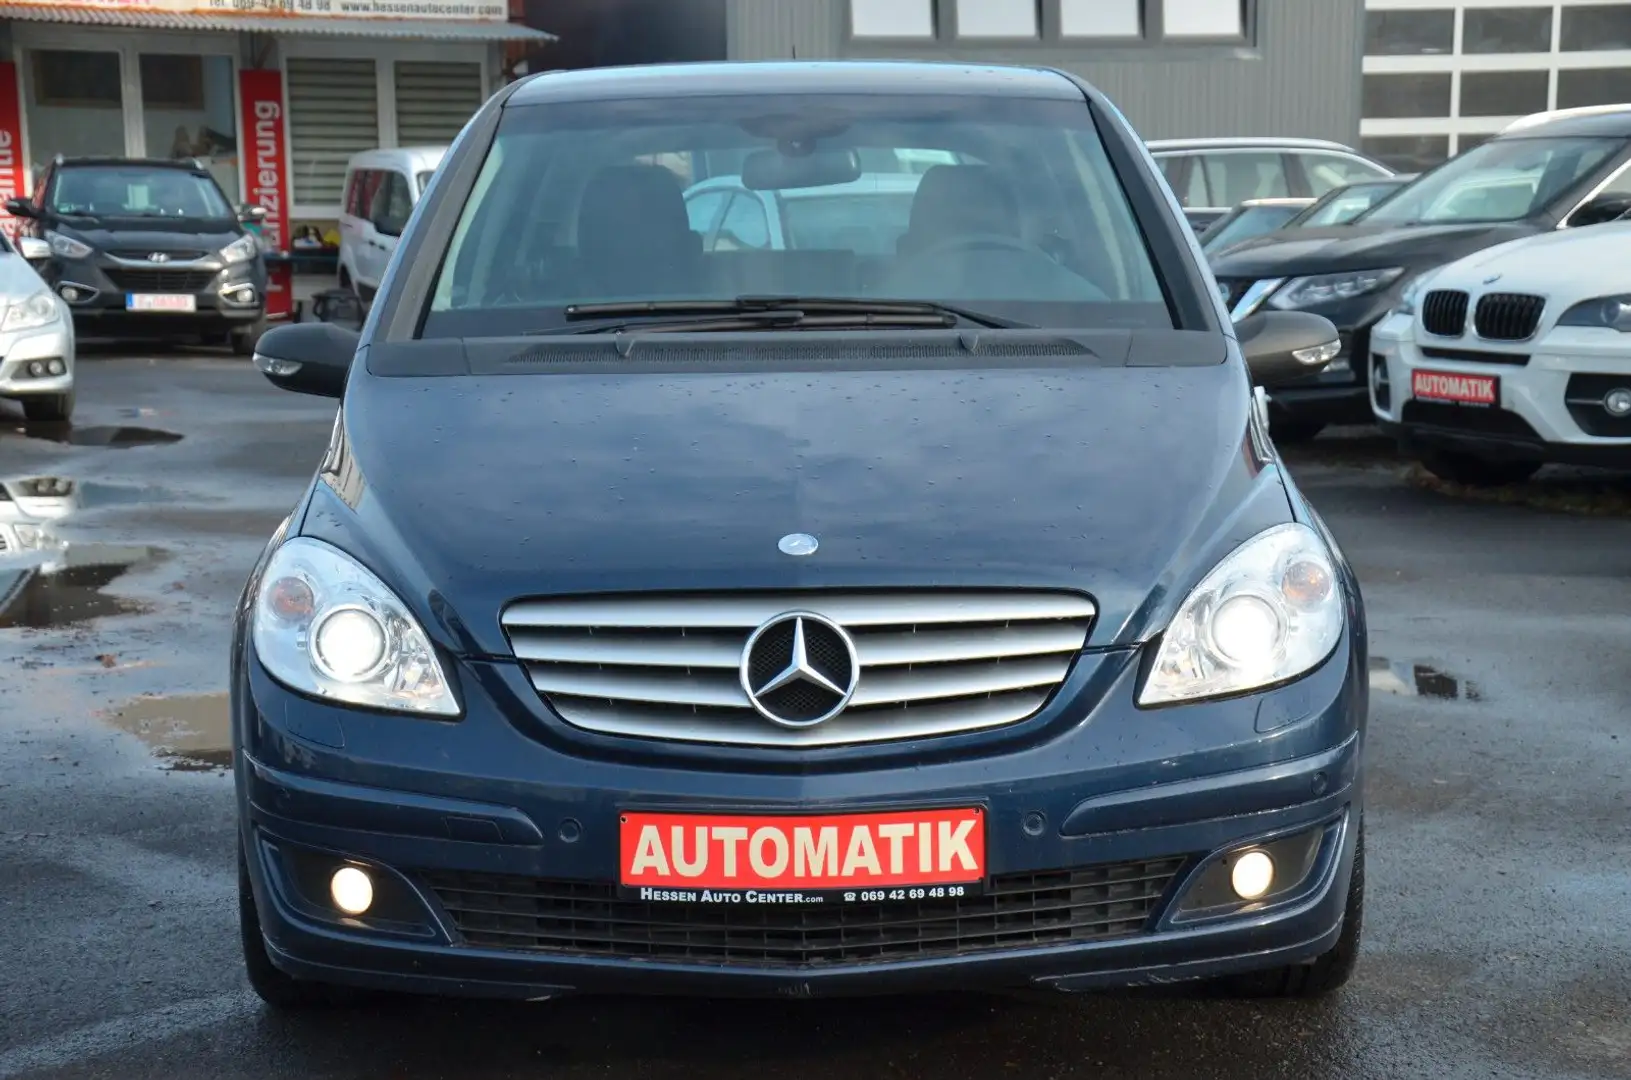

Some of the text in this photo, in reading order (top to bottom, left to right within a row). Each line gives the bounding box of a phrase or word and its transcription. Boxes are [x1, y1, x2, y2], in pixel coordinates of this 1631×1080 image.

[1415, 373, 1494, 400] AUTOMATIK
[630, 820, 979, 878] AUTOMATIK
[640, 887, 824, 904] HESSEN AUTO CENTER.com
[861, 886, 965, 901] 069 42 69 48 98
